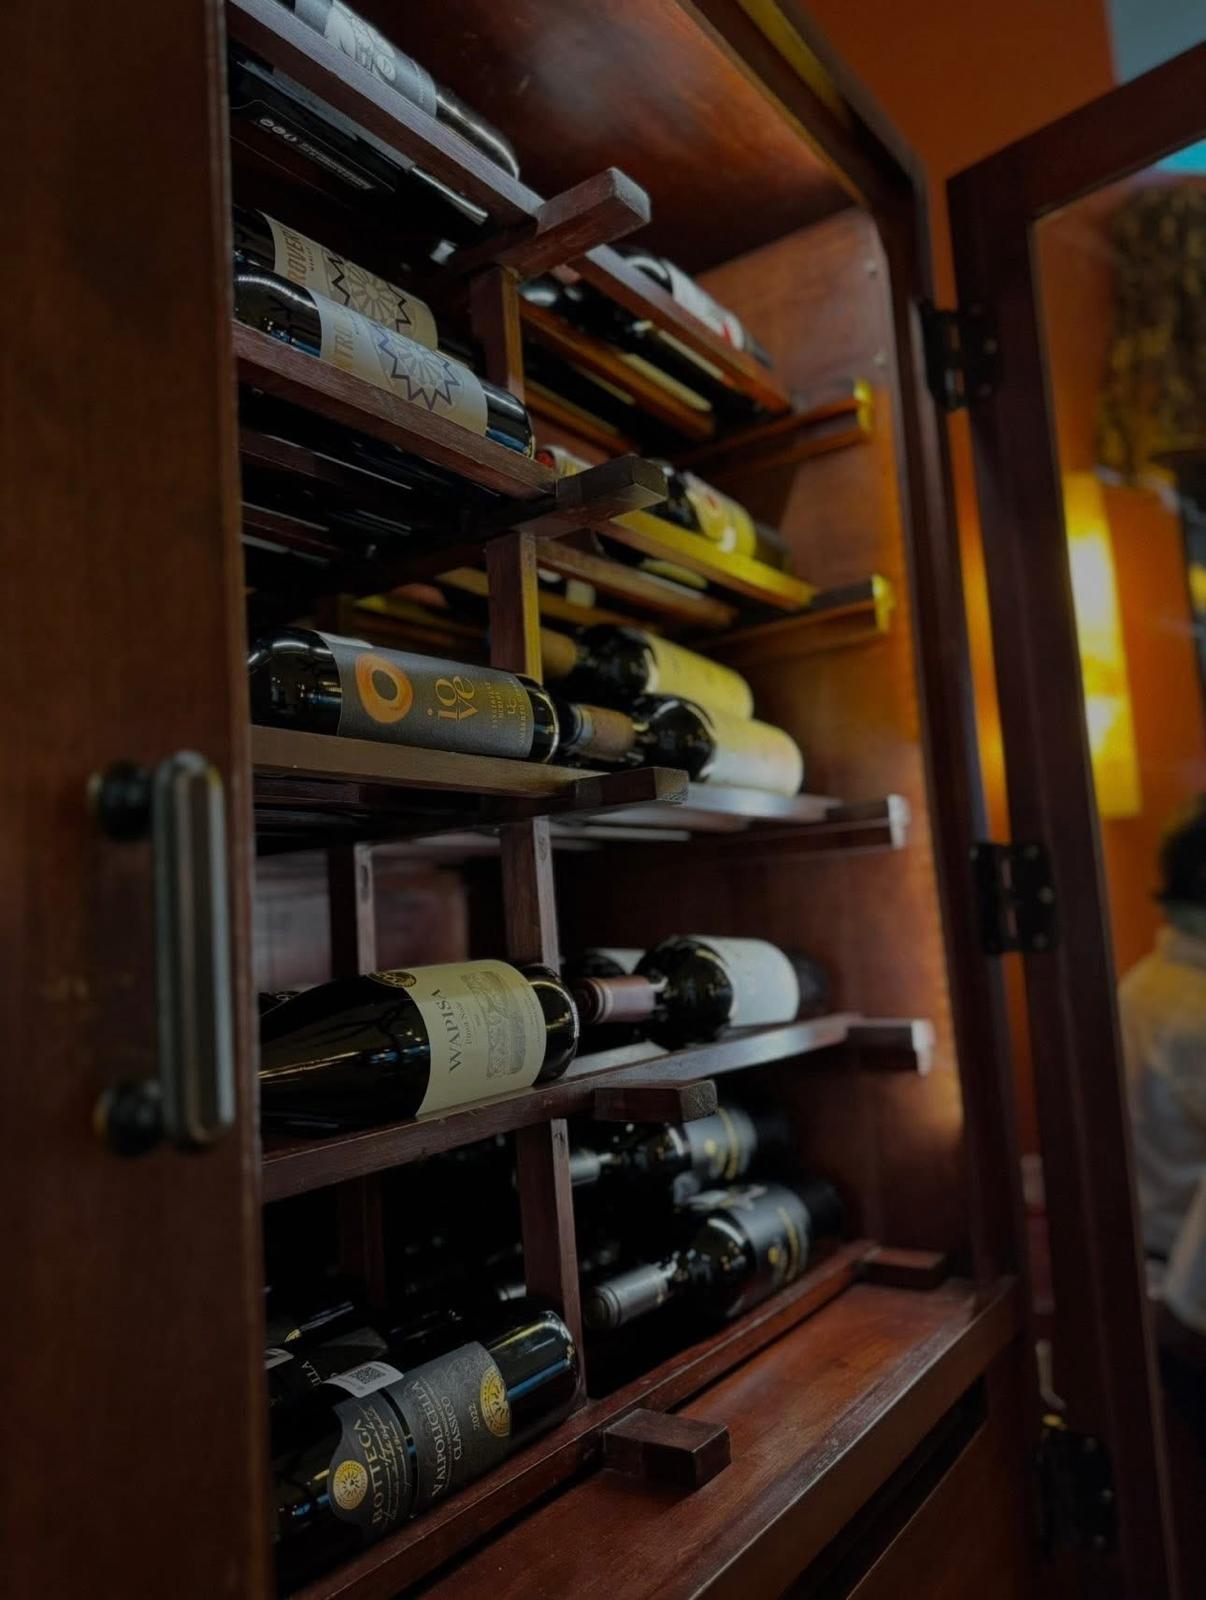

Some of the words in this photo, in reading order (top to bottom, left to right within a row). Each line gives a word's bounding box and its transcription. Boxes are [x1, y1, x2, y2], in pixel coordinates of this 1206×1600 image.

[430, 987, 464, 1074] WAPISA
[412, 1381, 450, 1498] VALPOLICELLA
[441, 1395, 465, 1462] CLASSICO
[468, 1401, 480, 1432] 2022
[352, 1418, 384, 1525] BOTTEGA
